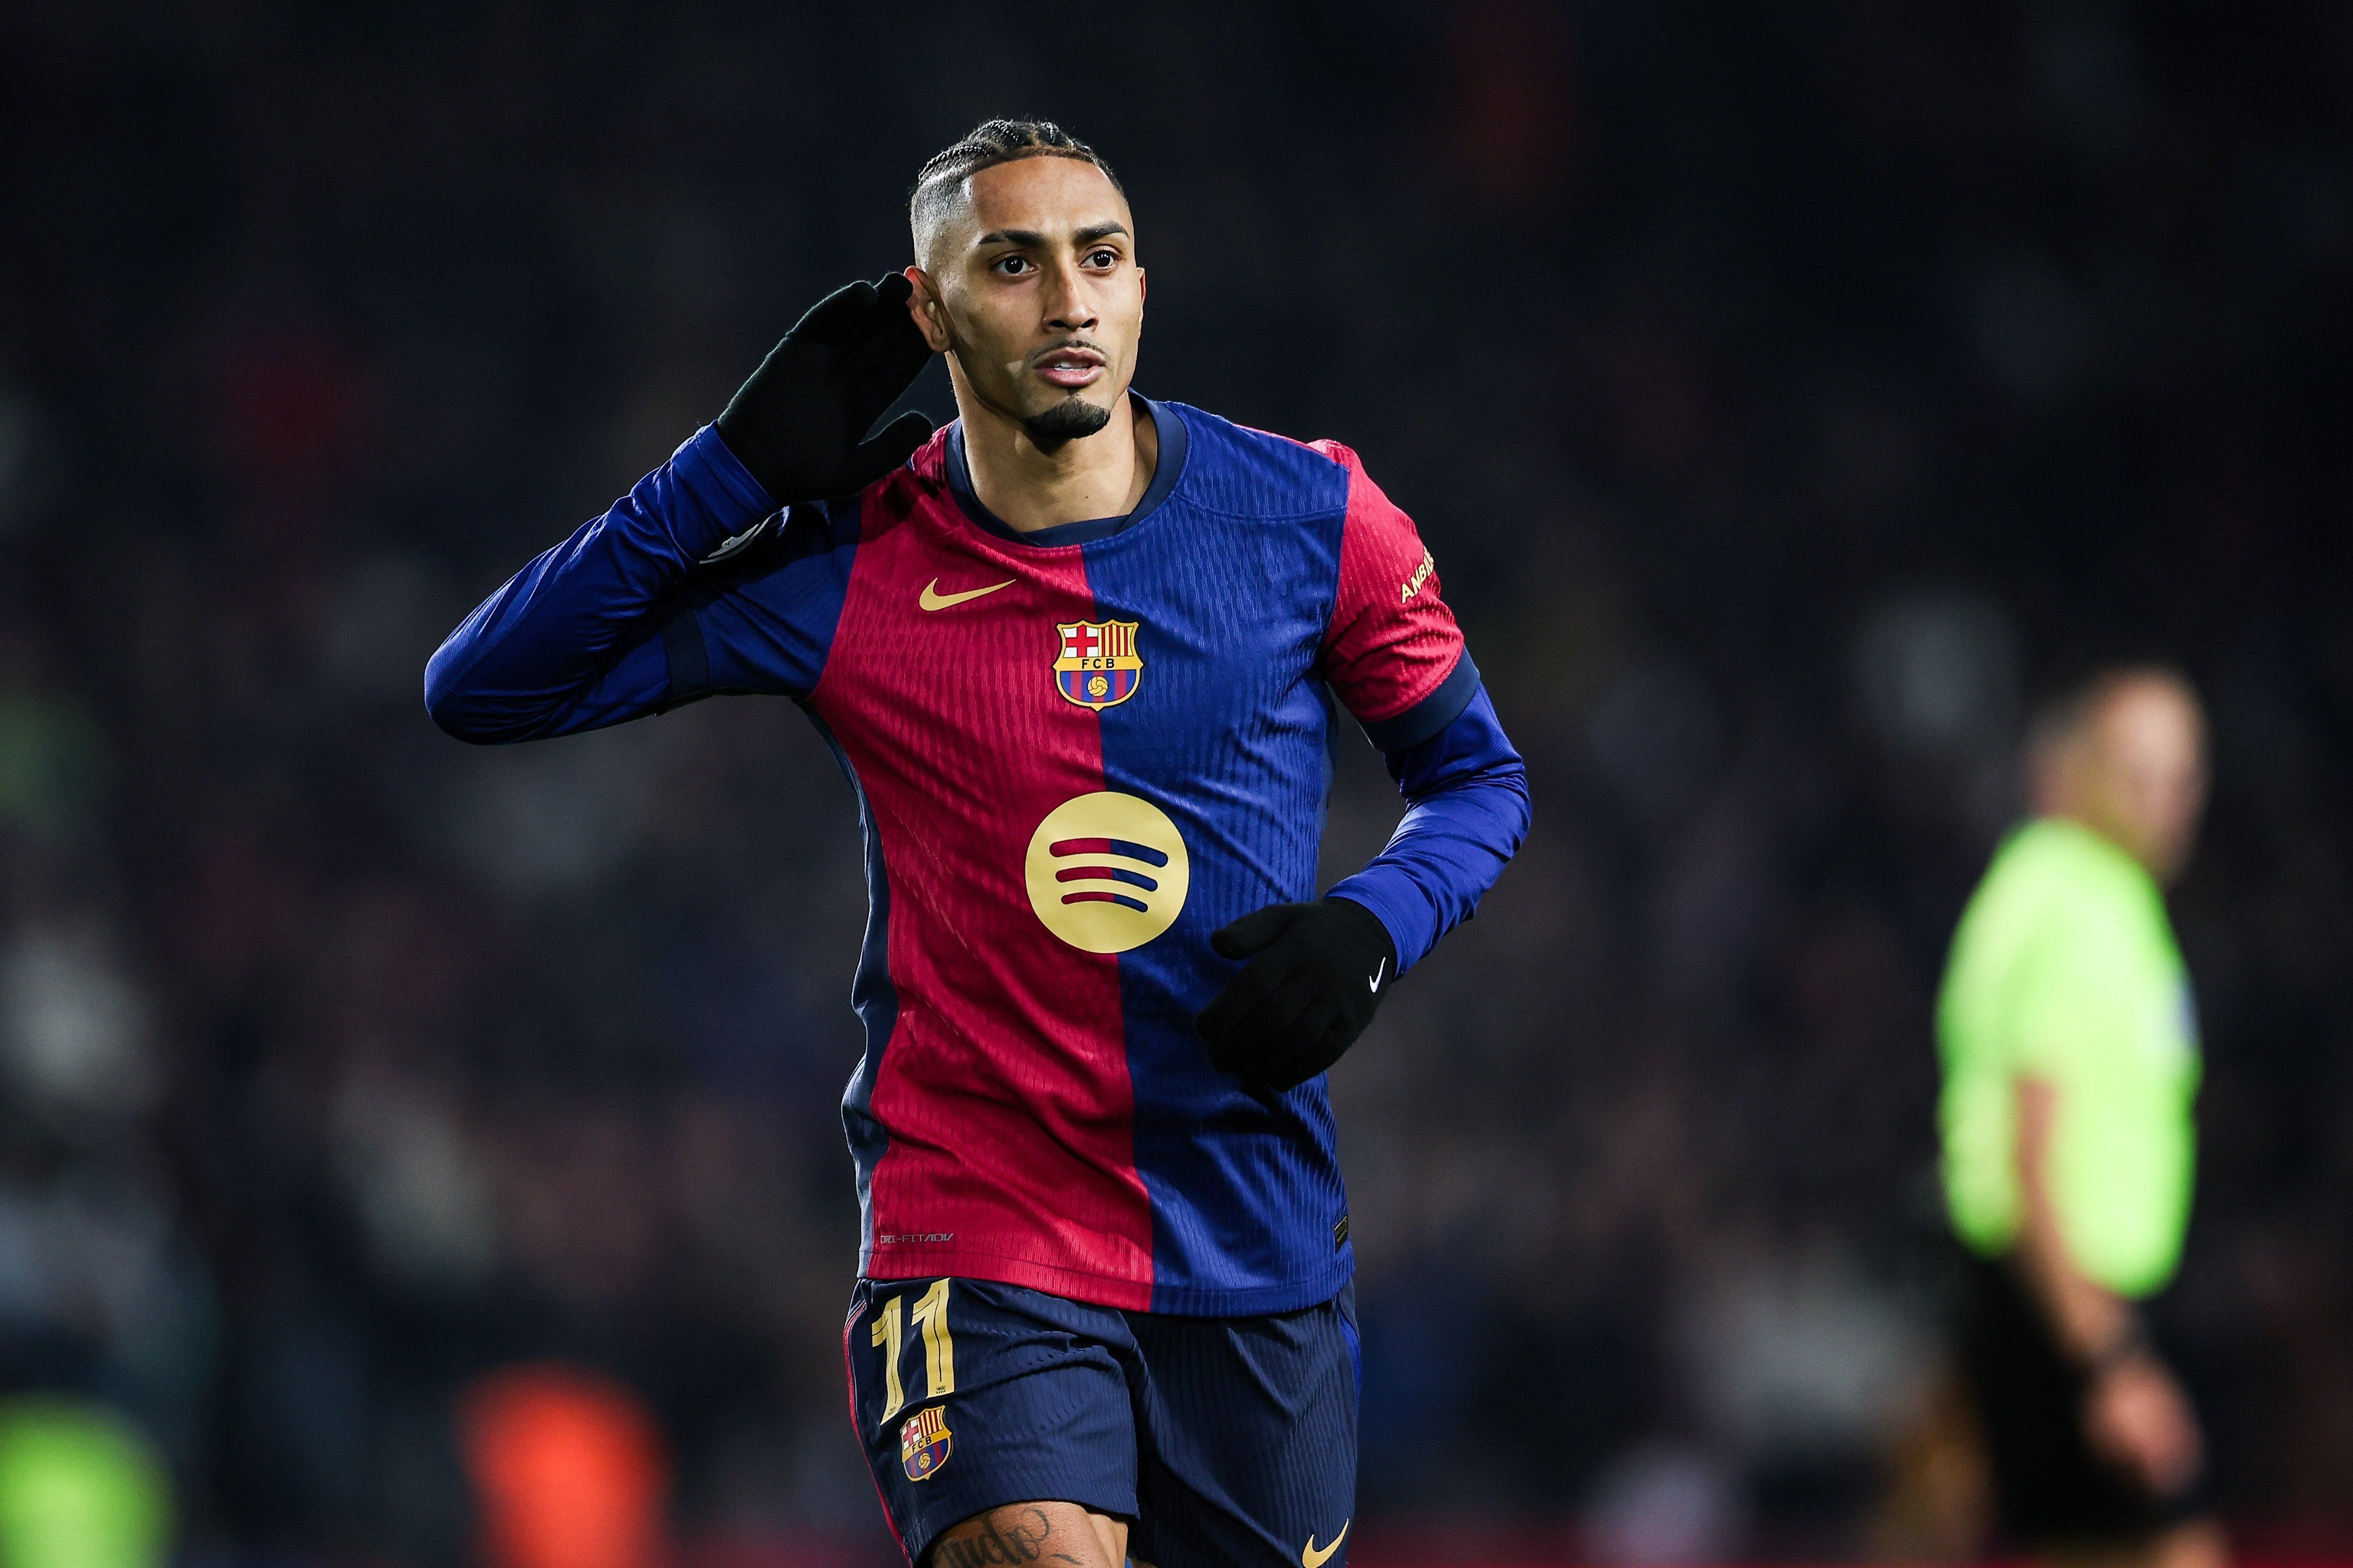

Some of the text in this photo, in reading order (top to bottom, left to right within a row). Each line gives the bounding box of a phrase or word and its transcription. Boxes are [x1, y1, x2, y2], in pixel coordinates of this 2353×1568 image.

[1082, 659, 1114, 669] FCB
[871, 1277, 955, 1426] 11
[912, 1436, 932, 1453] FCB
